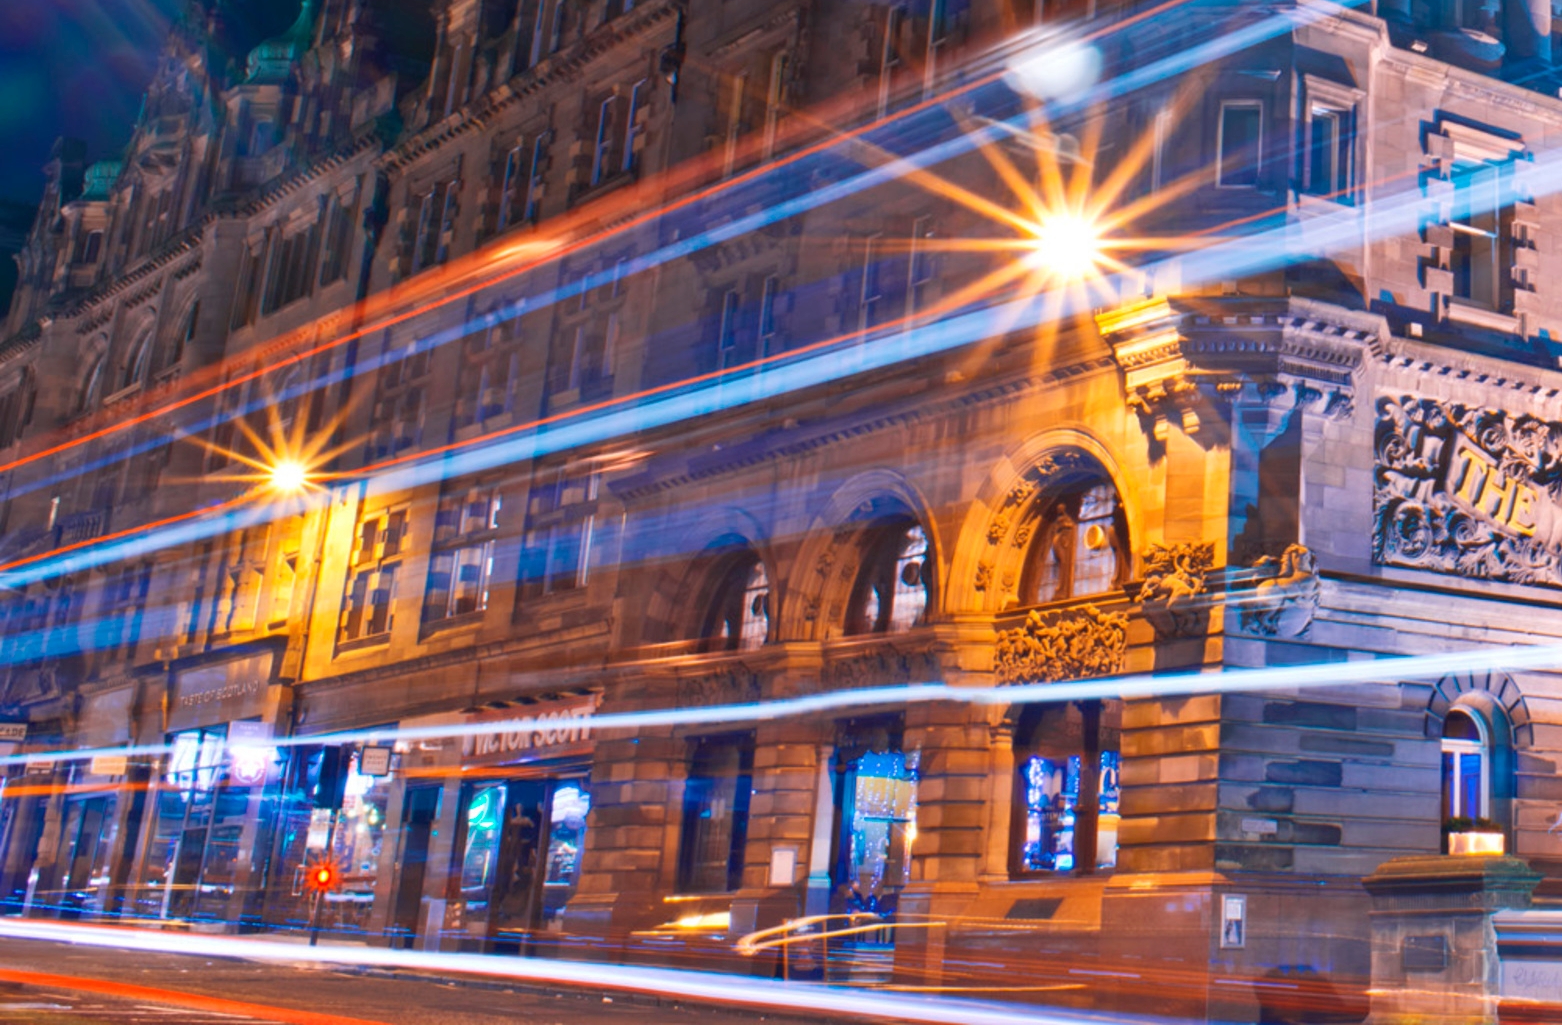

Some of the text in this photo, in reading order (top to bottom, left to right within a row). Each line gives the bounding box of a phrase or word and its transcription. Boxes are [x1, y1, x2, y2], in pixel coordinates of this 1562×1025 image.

[1455, 446, 1538, 536] THE
[475, 705, 596, 755] VICTOR SCOTT
